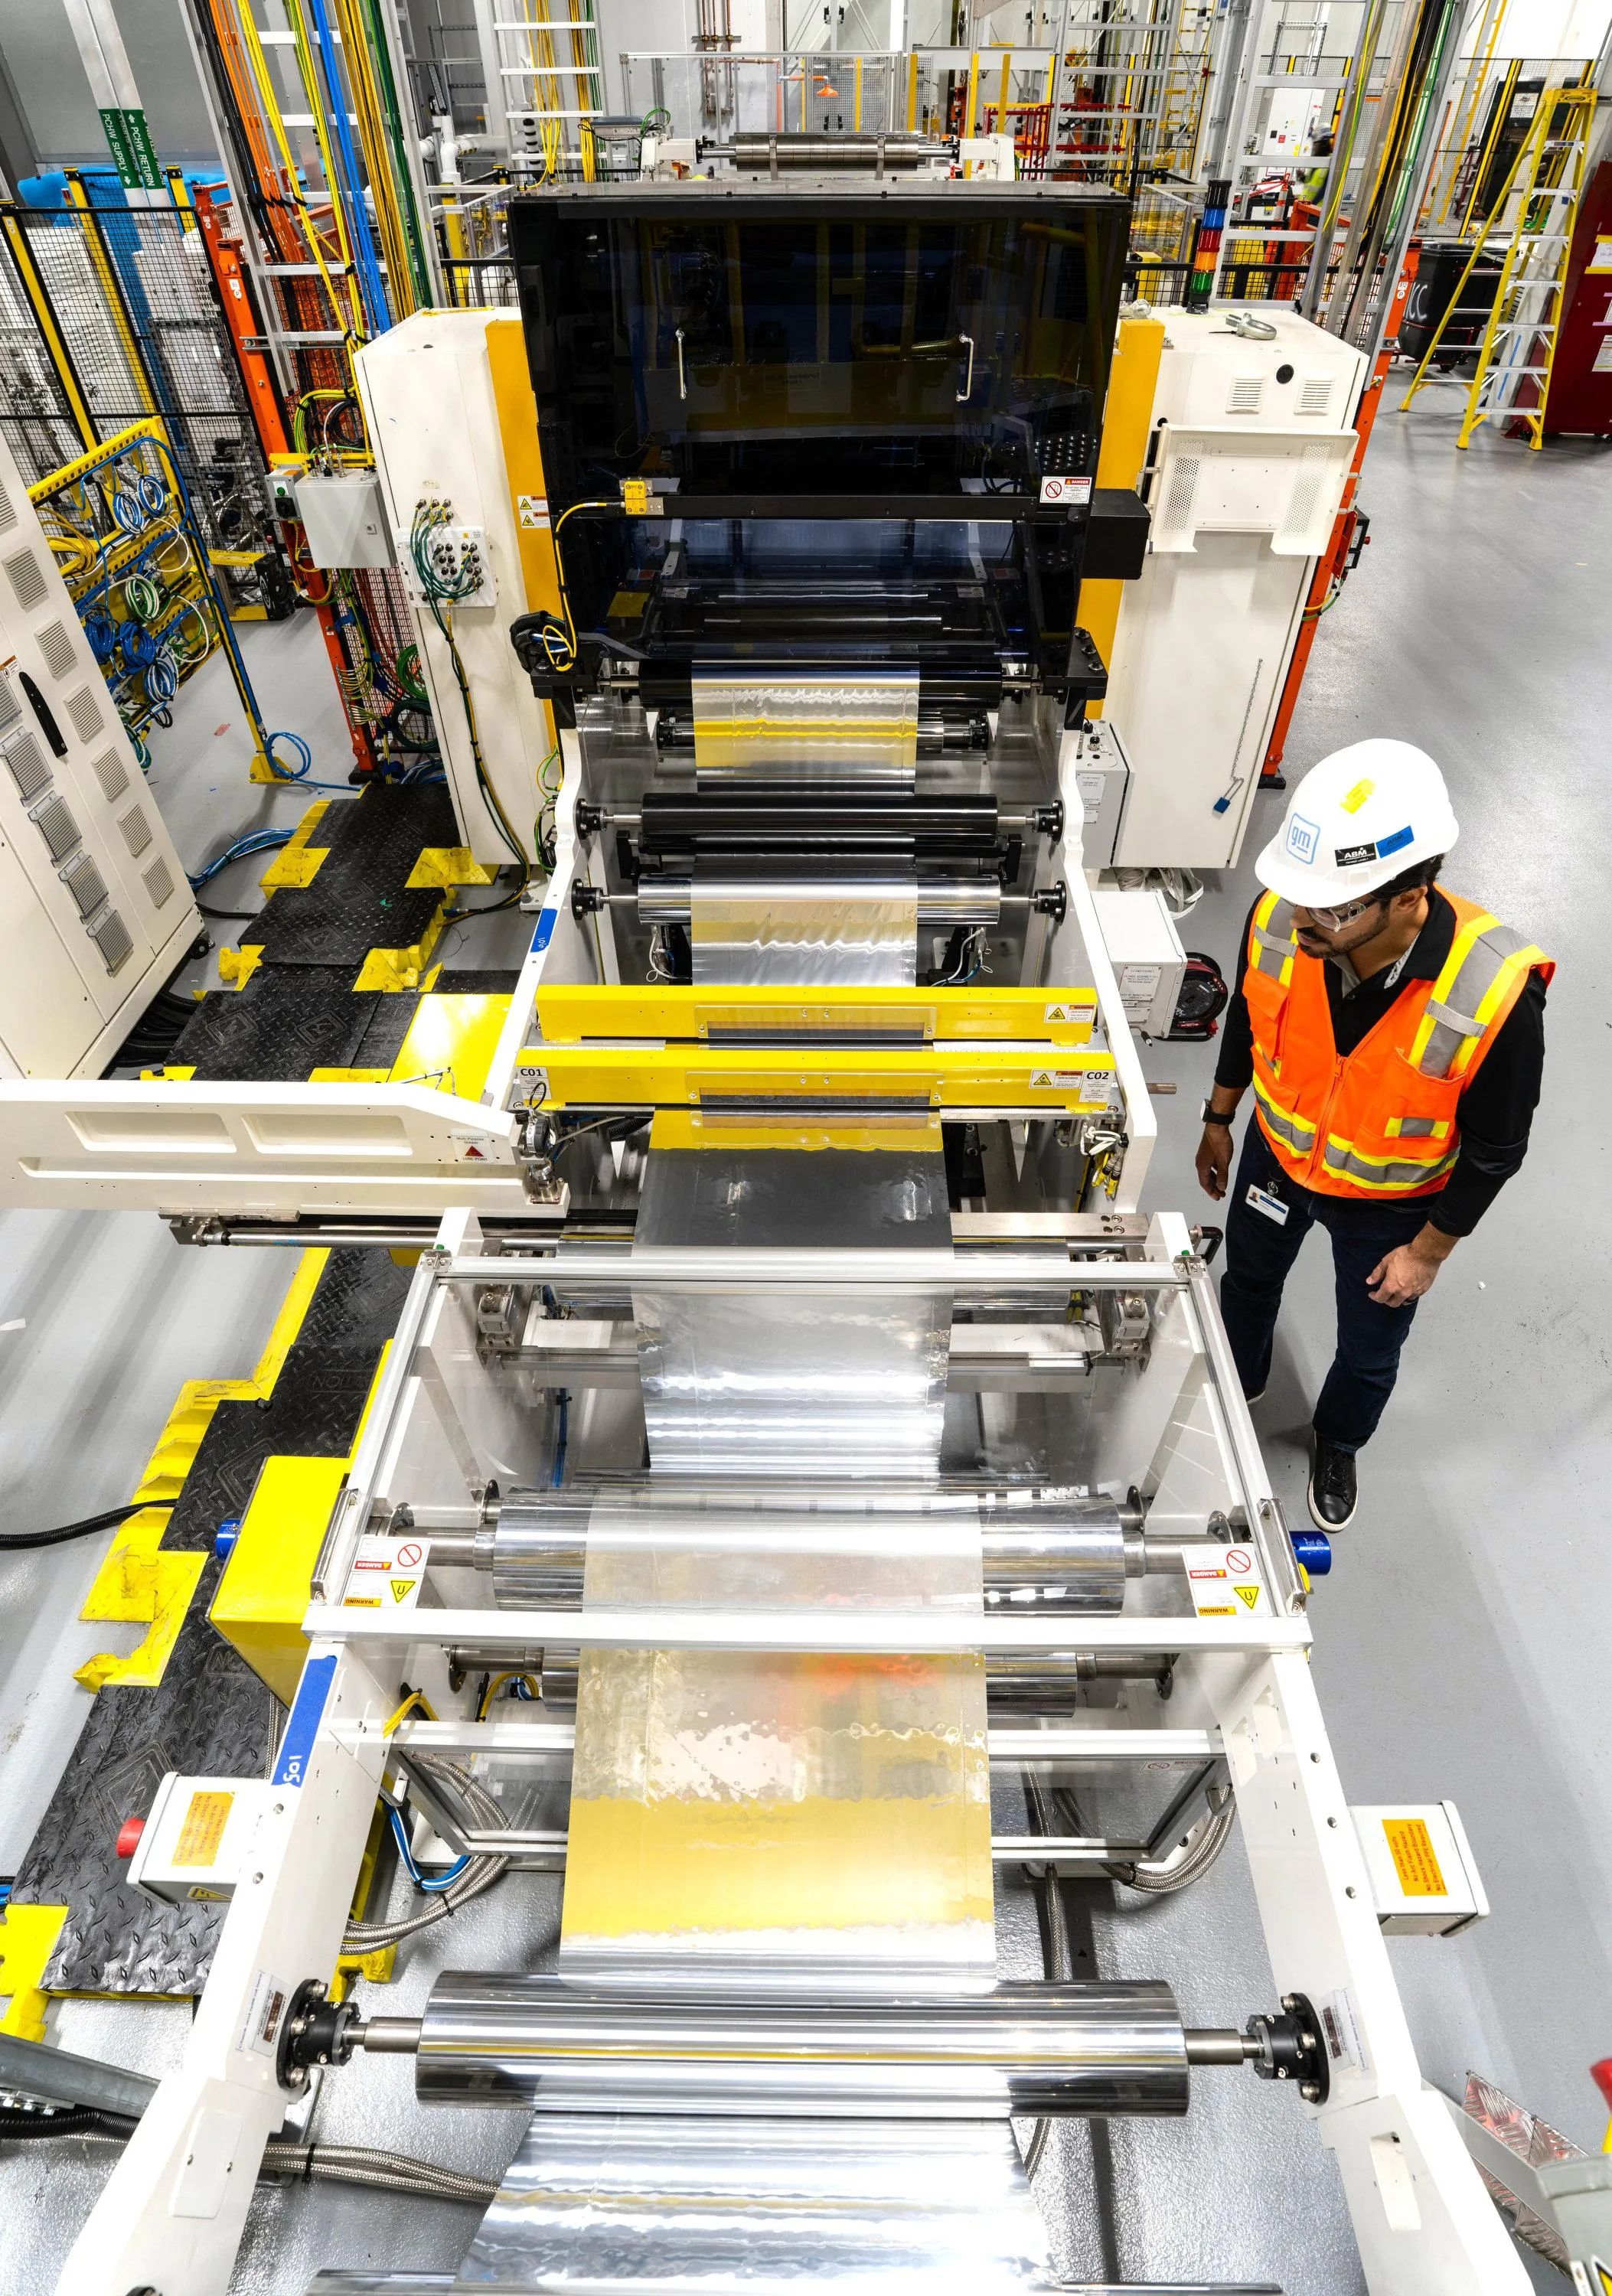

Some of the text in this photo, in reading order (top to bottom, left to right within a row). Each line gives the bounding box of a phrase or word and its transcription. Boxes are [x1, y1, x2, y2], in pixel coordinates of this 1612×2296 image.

[103, 114, 128, 171] PCHW SUPPLY
[131, 127, 155, 186] PCHW RETURN
[1291, 826, 1311, 849] gm
[1344, 847, 1368, 859] ABM
[520, 1068, 543, 1077] C01
[1087, 1071, 1109, 1080] C02
[1399, 1831, 1409, 1849] Hazard
[1408, 1824, 1418, 1847] Boundary
[1416, 1825, 1427, 1846] Required
[1415, 1848, 1424, 1866] Hazard
[1427, 1858, 1439, 1883] Electrical
